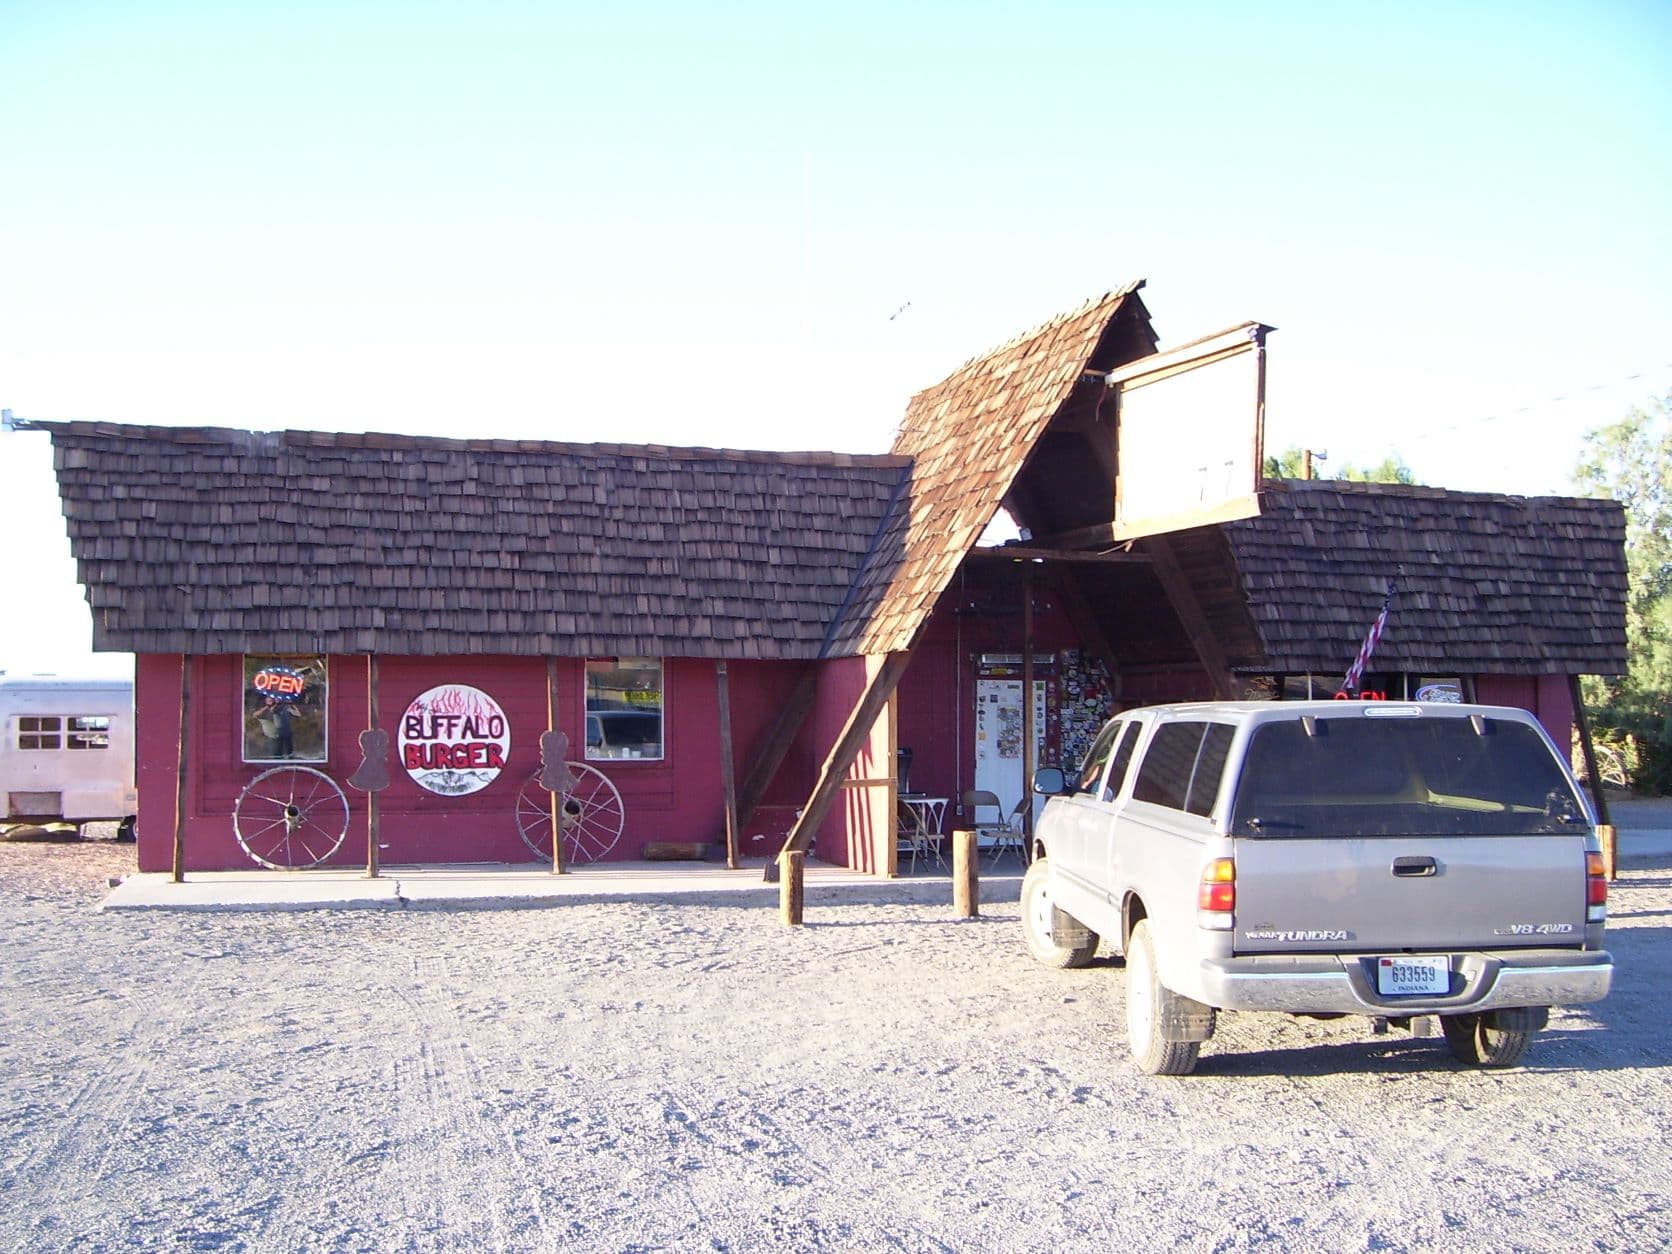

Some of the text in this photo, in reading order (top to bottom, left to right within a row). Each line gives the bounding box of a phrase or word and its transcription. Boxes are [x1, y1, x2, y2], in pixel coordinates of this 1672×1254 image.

[254, 673, 304, 694] OPEN
[405, 715, 505, 740] BUFFALO
[404, 742, 506, 770] BURGER
[1277, 930, 1348, 942] TUNDRA
[1511, 924, 1534, 935] V8
[1535, 923, 1573, 935] 4WD
[1392, 966, 1436, 983] 633559
